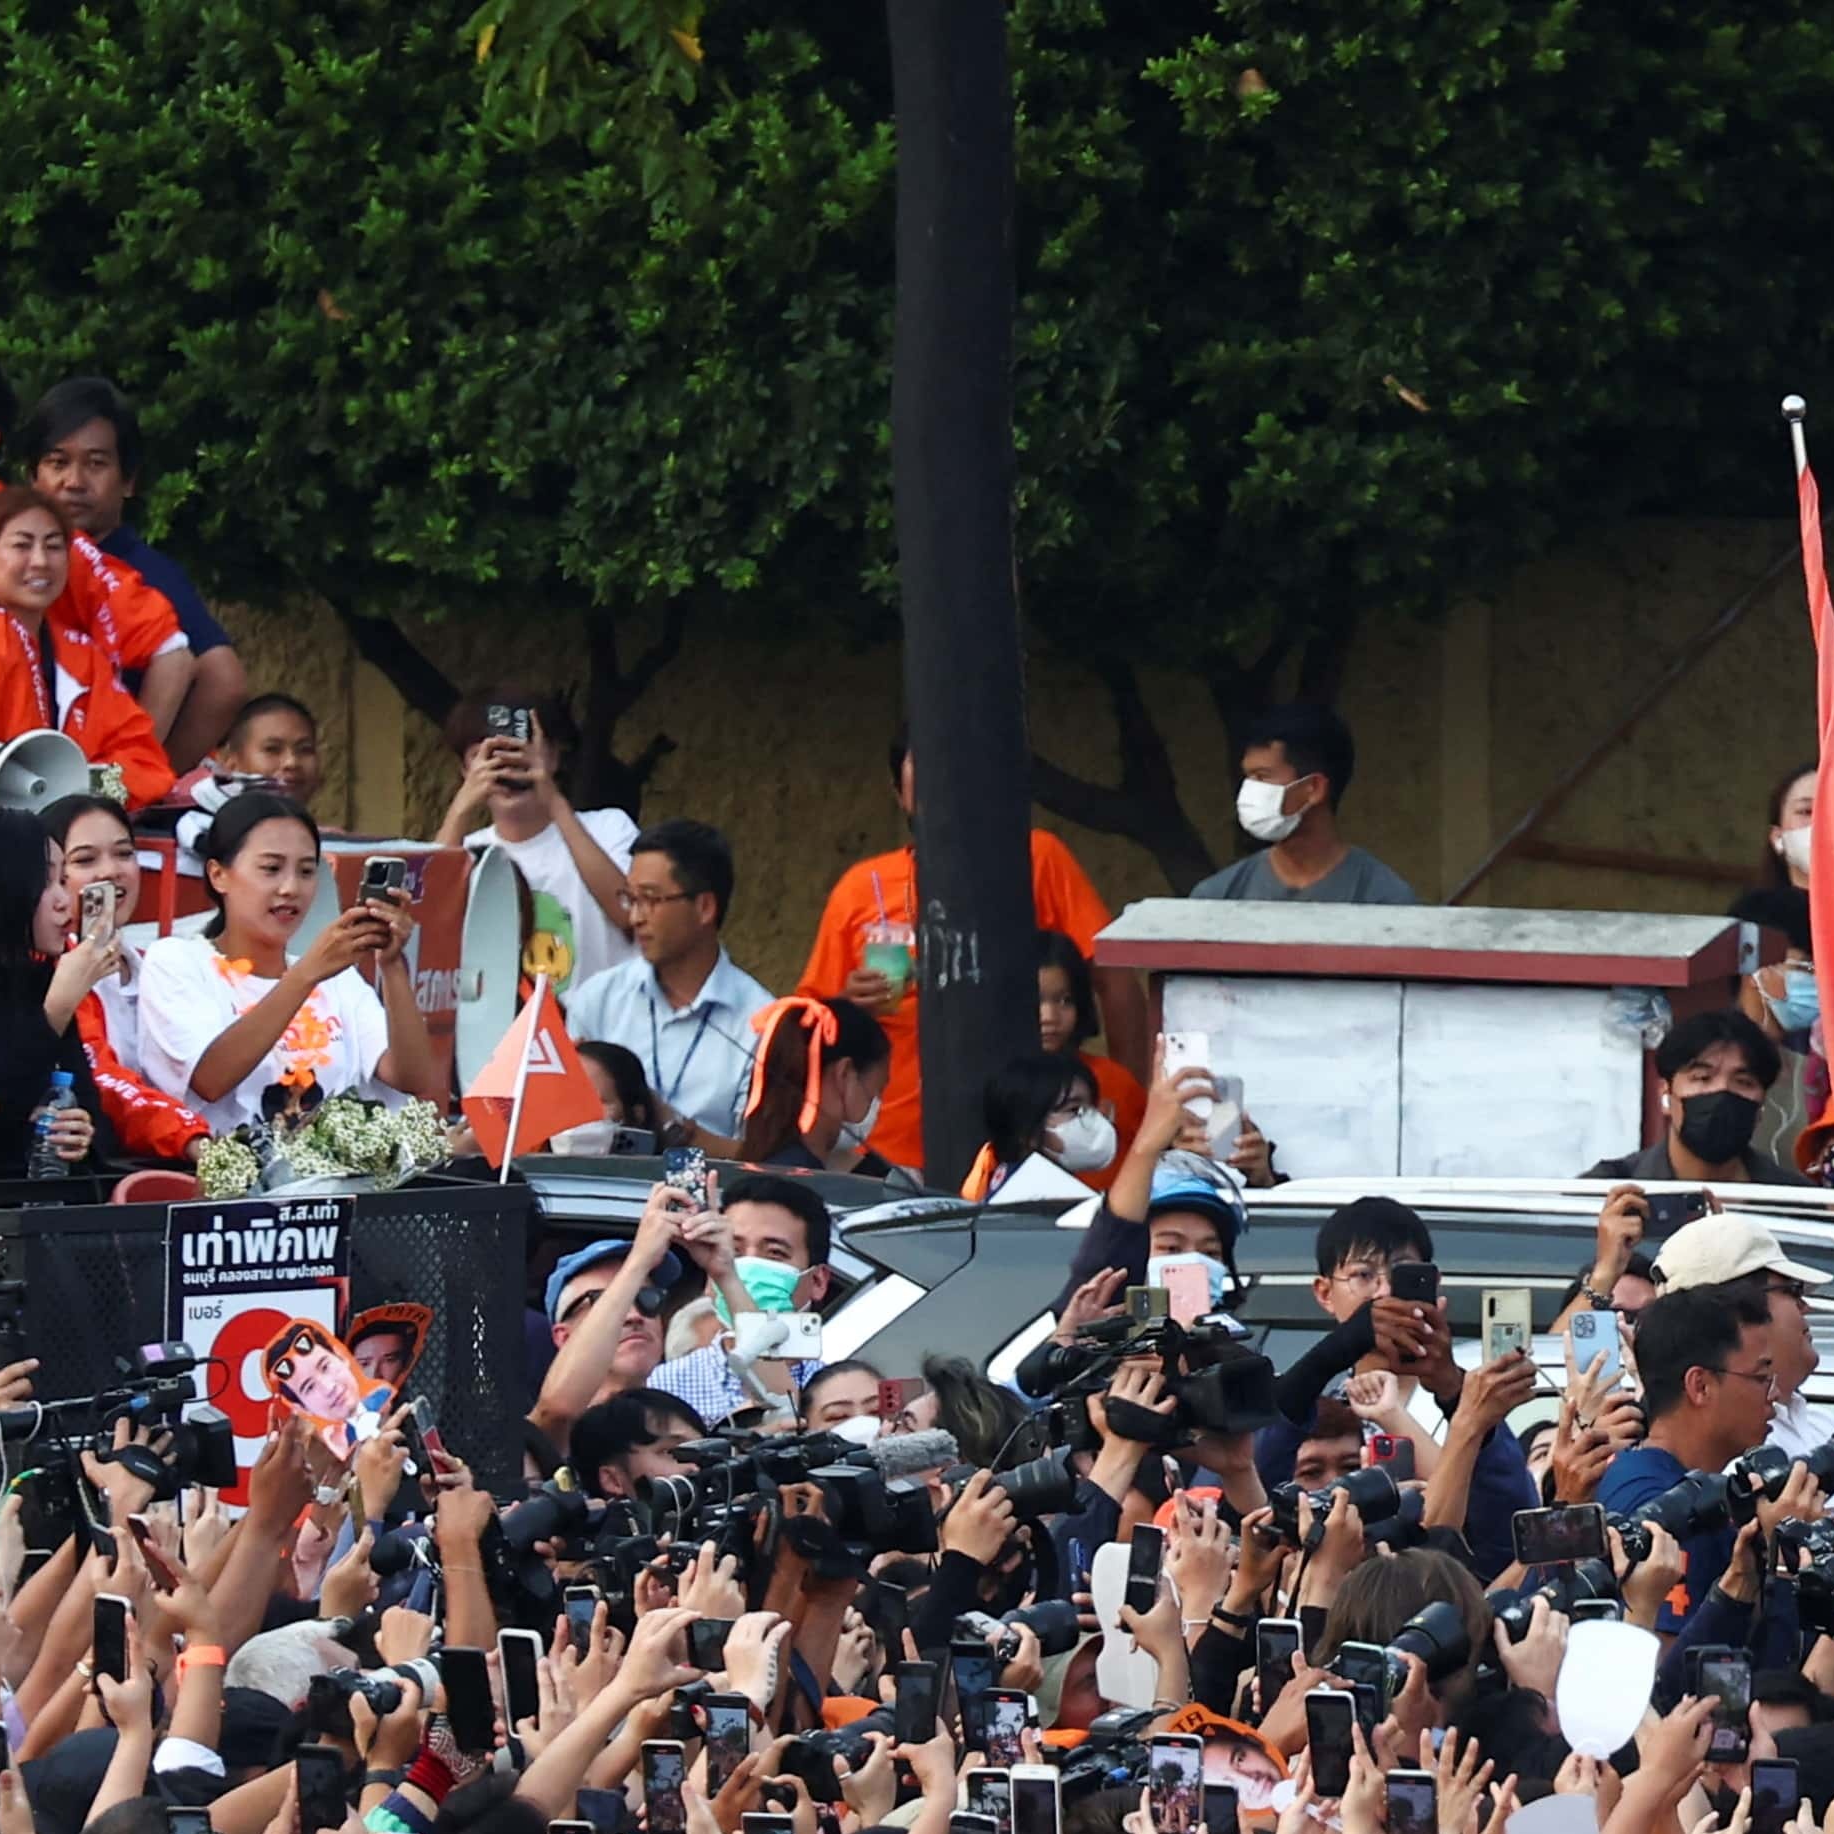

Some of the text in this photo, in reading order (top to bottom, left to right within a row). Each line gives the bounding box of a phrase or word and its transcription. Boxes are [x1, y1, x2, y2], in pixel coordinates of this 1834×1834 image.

[182, 1215, 339, 1267] เท่าพิภพ
[188, 1300, 223, 1319] เบอร์
